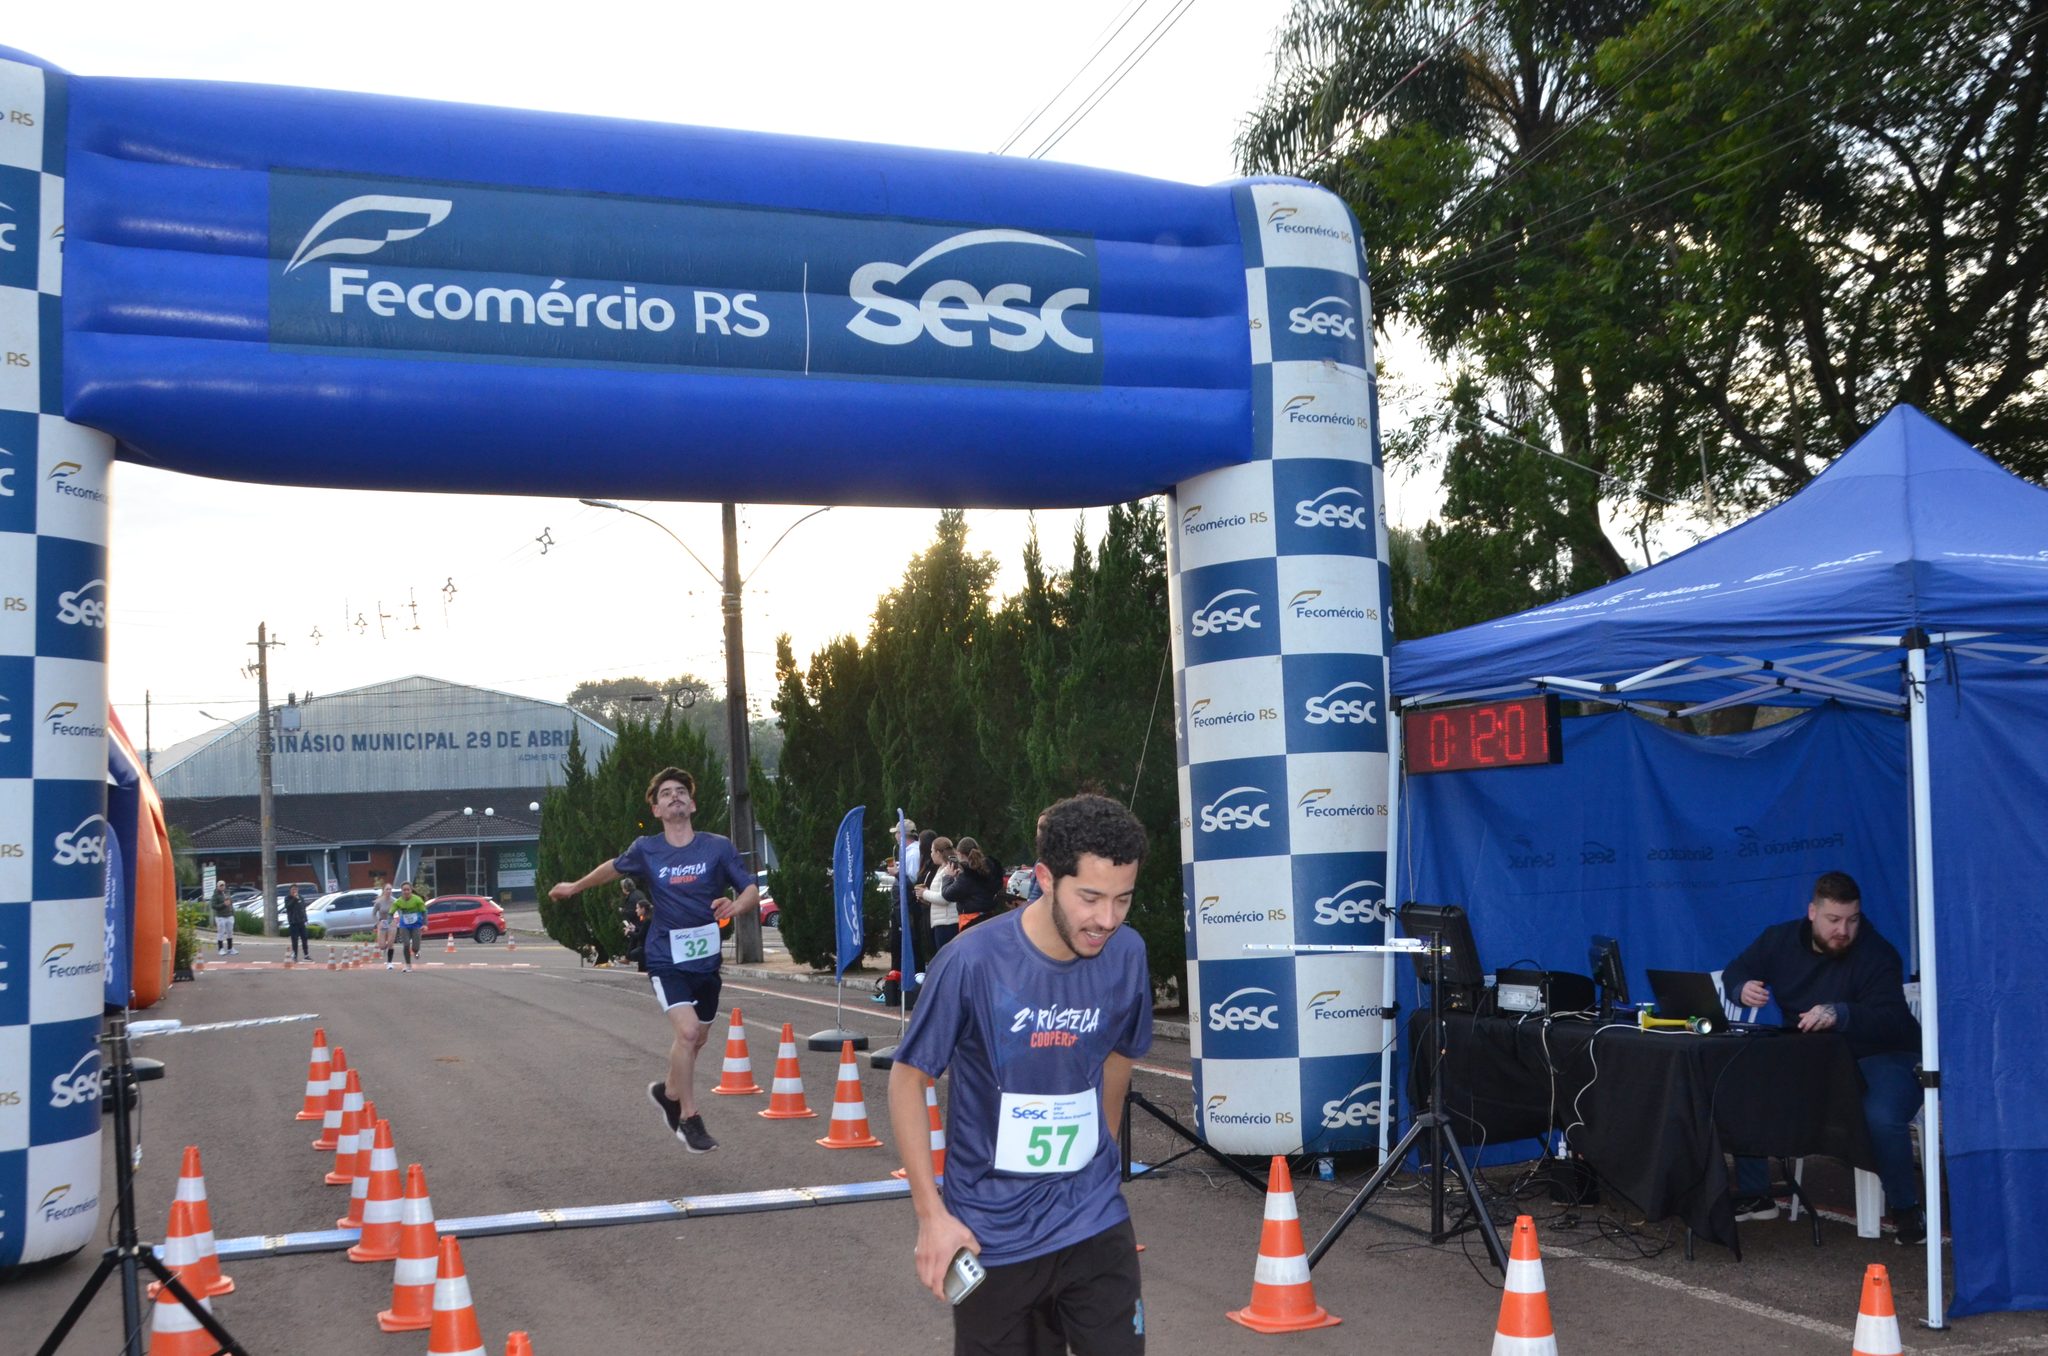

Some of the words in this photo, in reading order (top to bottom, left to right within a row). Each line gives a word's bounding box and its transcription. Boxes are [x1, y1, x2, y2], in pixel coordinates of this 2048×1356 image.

[10, 110, 34, 126] RS
[1276, 223, 1339, 239] Fecomércio
[330, 266, 676, 332] Fecomércio
[693, 291, 770, 337] RS
[846, 258, 1094, 354] Sesc
[1289, 306, 1356, 340] Sesc
[7, 352, 30, 367] RS
[1290, 412, 1355, 426] Fecomércio
[1357, 416, 1368, 429] RS
[1185, 514, 1246, 535] Fecomércio
[1250, 512, 1268, 523] RS
[1295, 499, 1366, 530] Sesc
[4, 597, 27, 612] RS
[1296, 607, 1364, 619] Fecomércio
[1366, 609, 1378, 620] RS
[1191, 604, 1261, 637] Sesc
[1194, 711, 1254, 728] Fecomércio
[1259, 709, 1277, 720] RS
[1304, 696, 1376, 725] Sesc
[352, 731, 460, 751] MUNICIPAL
[466, 731, 491, 749] 29
[497, 730, 521, 748] DE
[1200, 803, 1270, 833] Sesc
[1306, 804, 1374, 817] Fecomércio
[1377, 805, 1388, 816] RS
[1, 844, 24, 858] RS
[1202, 911, 1264, 925] Fecomércio
[1267, 909, 1286, 920] RS
[684, 938, 708, 958] 32
[1209, 1003, 1279, 1032] Sesc
[1012, 1106, 1048, 1120] Sesc
[1210, 1111, 1271, 1124] Fecomércio
[1275, 1112, 1294, 1123] RS
[1026, 1124, 1079, 1167] 57
